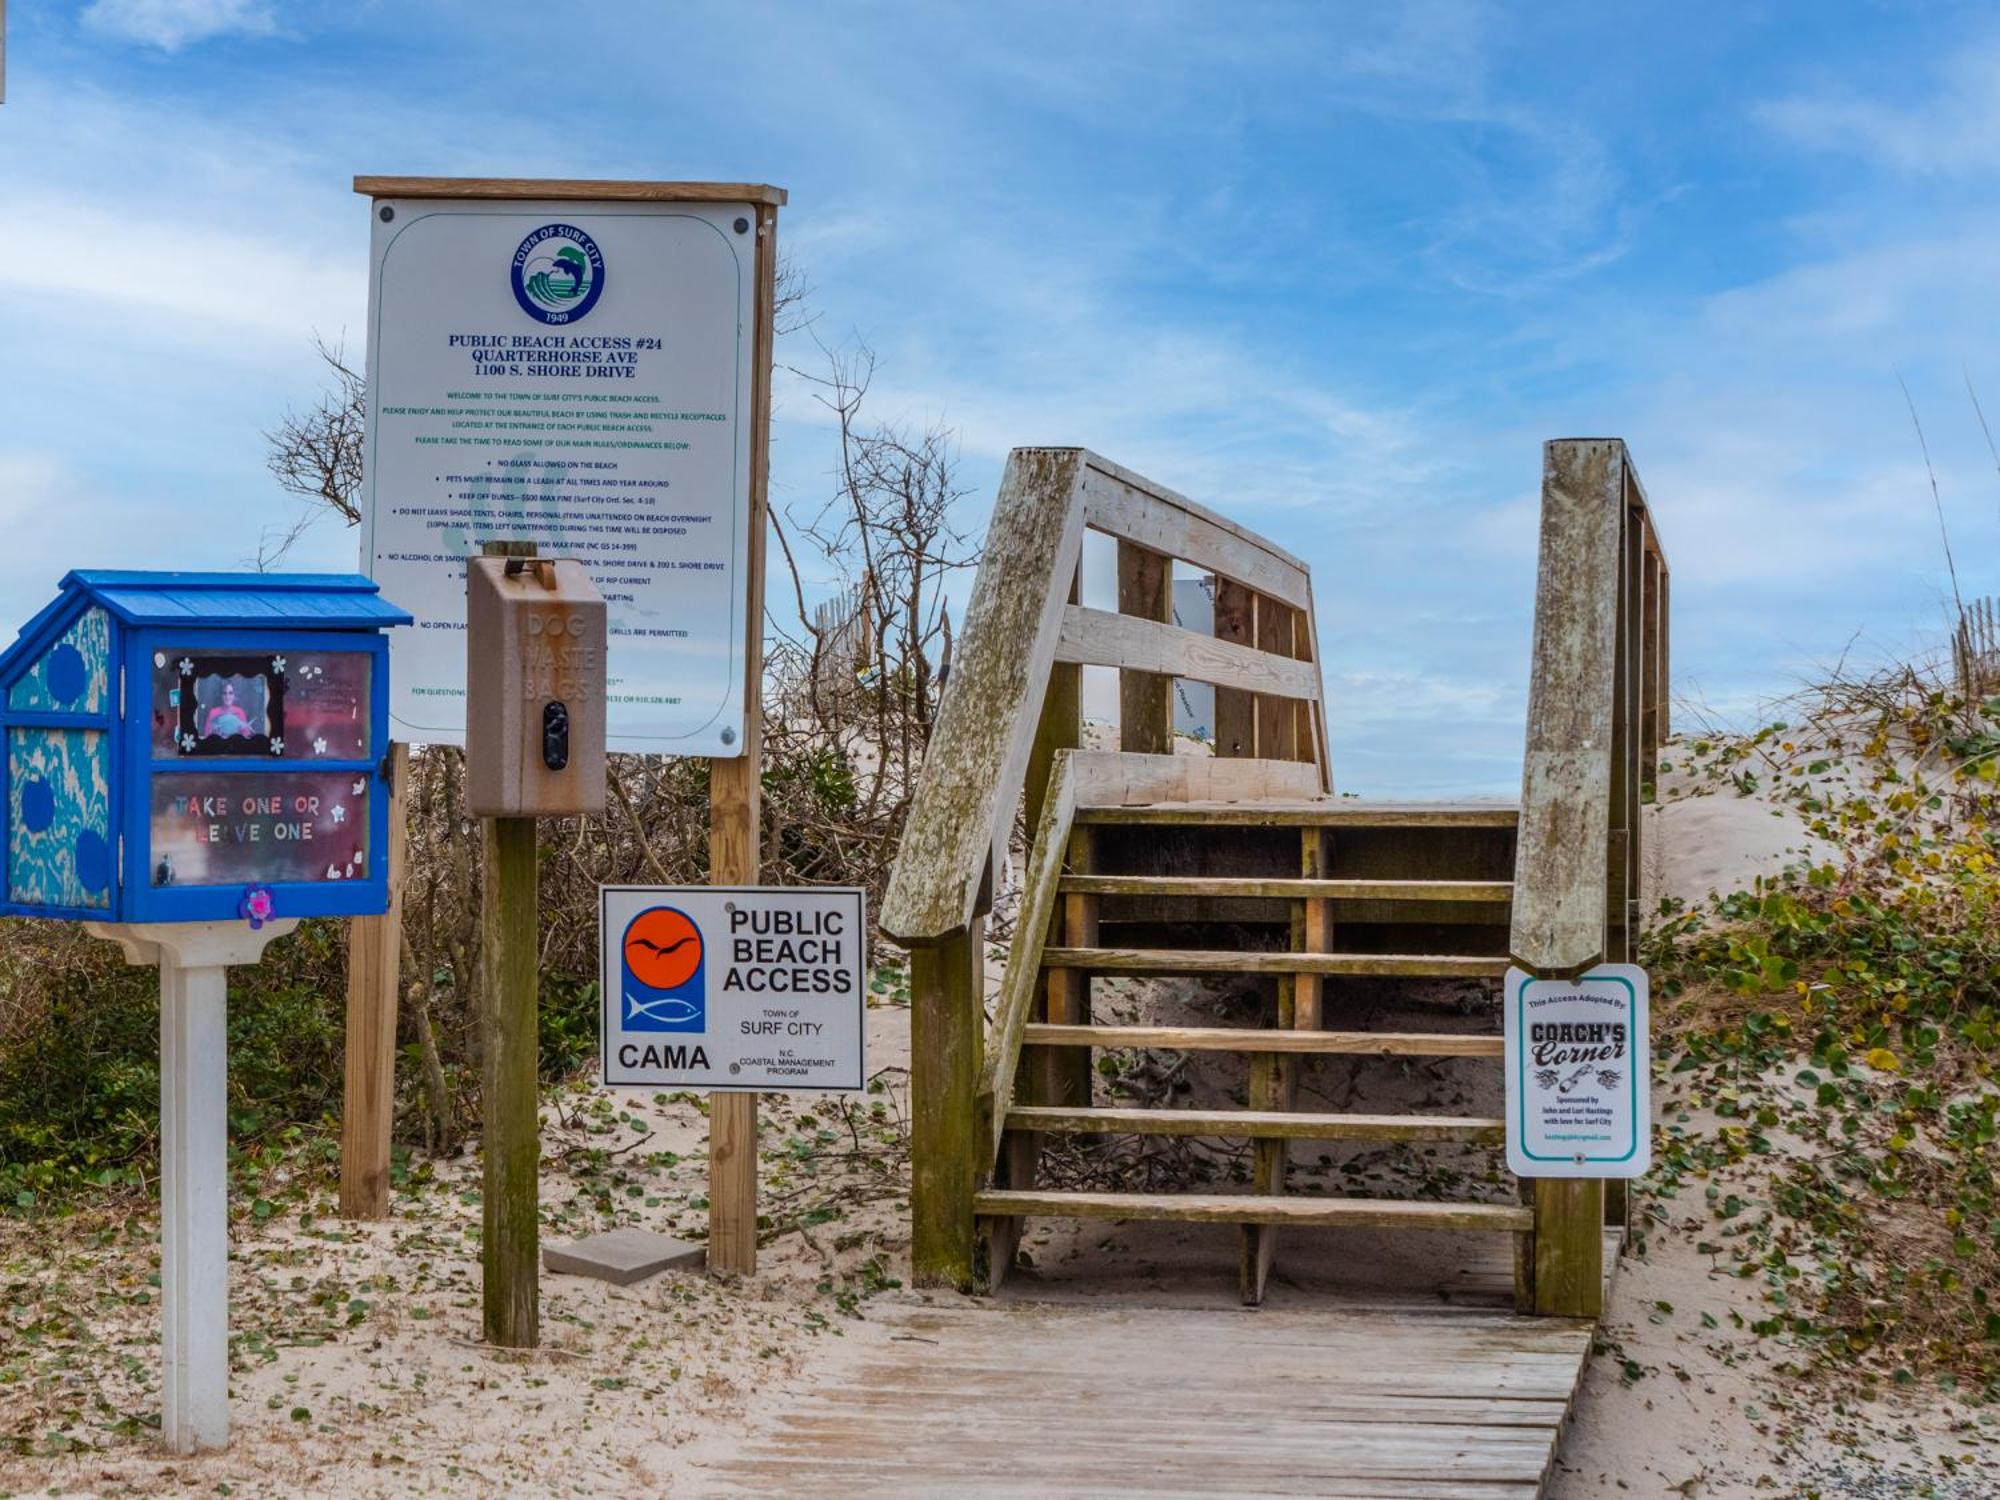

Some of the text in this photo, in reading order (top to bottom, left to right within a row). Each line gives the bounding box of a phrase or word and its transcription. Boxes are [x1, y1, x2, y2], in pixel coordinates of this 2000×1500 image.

[514, 226, 603, 268] TOWN OF SURF CITY
[546, 312, 569, 323] 1949
[449, 335, 663, 350] PUBLIC BEACH ACCESS #24
[472, 350, 638, 363] QUARTERHORSE AVE
[475, 365, 635, 378] 1100 S. SHORE DRIVE
[595, 462, 617, 470] BEACH
[485, 476, 512, 484] REMAIN
[533, 477, 553, 485] LEASH
[566, 478, 578, 486] ALL
[580, 478, 600, 486] TIMES
[602, 479, 617, 487] AND
[619, 479, 636, 487] YEAR
[638, 480, 670, 488] AROUND
[602, 560, 625, 568] SHORE
[678, 562, 702, 570] SHORE
[620, 577, 651, 585] CURRENT
[433, 622, 451, 630] OPEN
[528, 613, 587, 637] DOG
[522, 645, 598, 669] WASTE
[523, 679, 589, 702] BAGS
[175, 796, 319, 816] TAKE ONE OR
[274, 822, 313, 841] ONE
[730, 910, 843, 935] PUBLIC
[734, 938, 841, 964] BEACH
[723, 967, 851, 993] ACCESS
[1528, 995, 1626, 1009] This Access Adopted By
[763, 1009, 799, 1018] TOWN OF
[740, 1021, 823, 1035] SURF CITY
[1531, 1022, 1626, 1043] COACH'S
[619, 1044, 711, 1070] CAMA
[1531, 1040, 1626, 1066] Corner
[739, 1058, 835, 1067] COASTAL MANAGEMENT
[767, 1067, 808, 1076] PROGRAM
